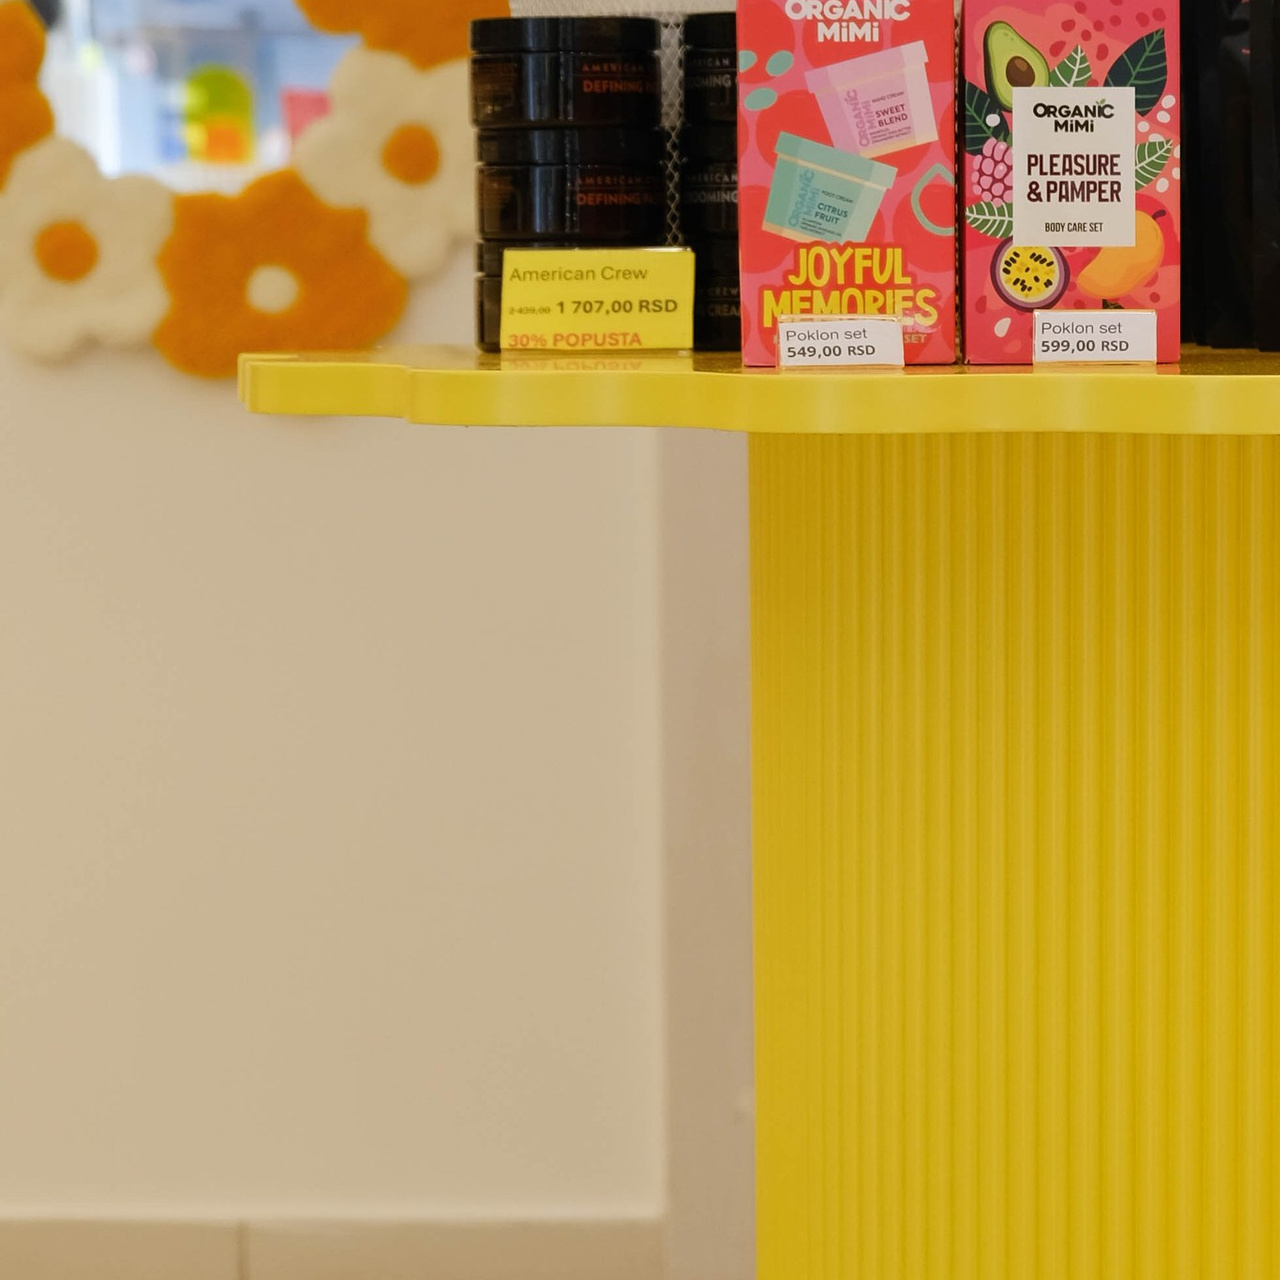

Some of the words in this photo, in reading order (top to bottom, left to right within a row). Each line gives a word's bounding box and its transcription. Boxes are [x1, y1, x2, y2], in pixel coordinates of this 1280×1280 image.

[582, 79, 643, 93] DEFINING
[875, 104, 906, 118] SWEET
[1033, 102, 1115, 119] ORGANIC
[878, 113, 908, 127] BLEND
[1027, 154, 1121, 176] PLEASURE
[576, 193, 642, 205] DEFINING
[1027, 181, 1043, 202] &
[1046, 181, 1122, 203] PAMPER
[817, 202, 849, 218] CITRUS
[814, 212, 840, 225] FRUIT
[1045, 222, 1065, 232] BODY
[1067, 222, 1087, 232] CARE
[1089, 222, 1103, 232] SET
[788, 246, 912, 287] JOYFUL
[509, 267, 596, 282] American
[600, 266, 648, 281] Crew
[557, 301, 565, 314] 1
[573, 300, 633, 315] 707,00
[639, 299, 678, 313] RSD
[763, 288, 939, 328] MEMORIES
[786, 330, 839, 342] Poklon
[844, 328, 868, 340] set
[1041, 322, 1094, 335] Poklon
[1099, 322, 1123, 334] set
[508, 333, 547, 348] 30%
[553, 332, 642, 347] POPUSTA
[1041, 339, 1096, 353] 599,00
[1101, 340, 1129, 352] RSD
[787, 345, 842, 359] 549,00
[848, 345, 876, 356] RSD
